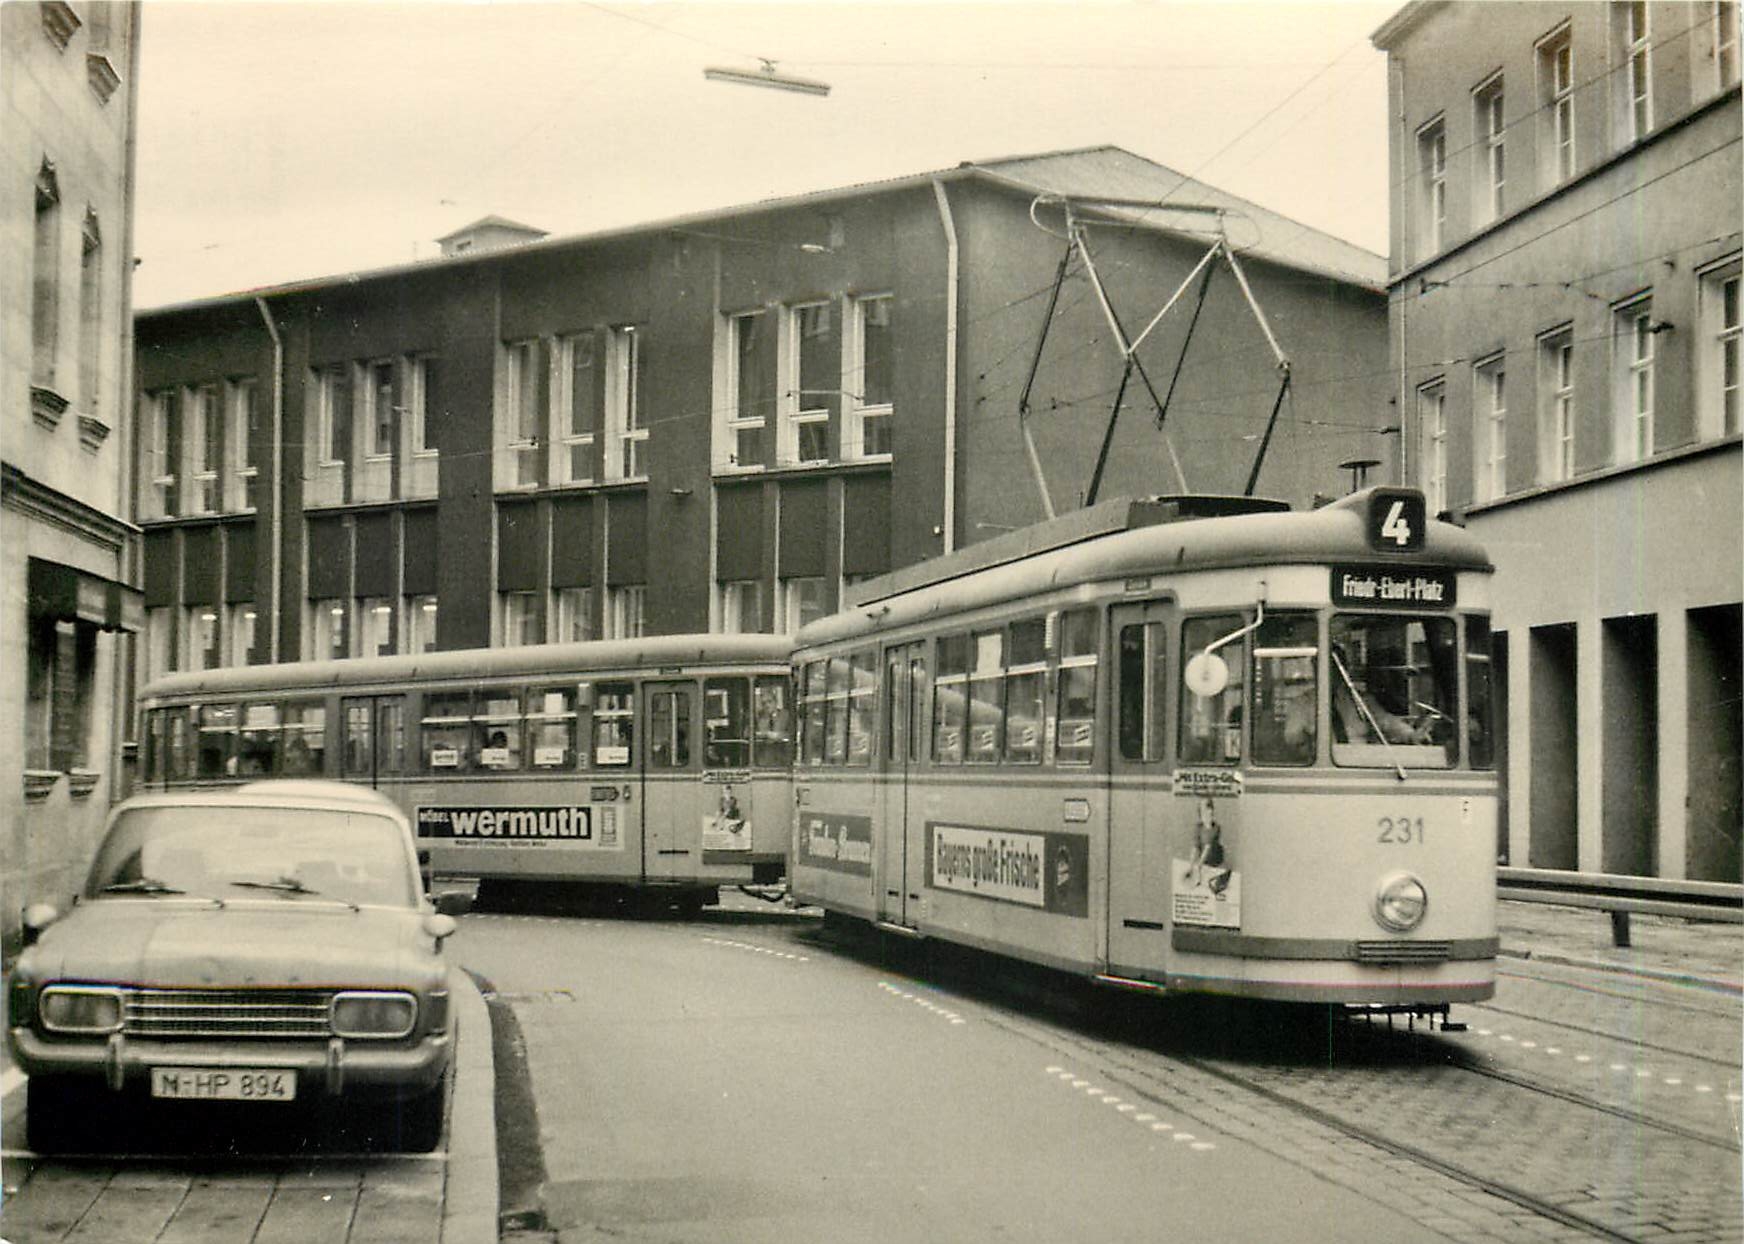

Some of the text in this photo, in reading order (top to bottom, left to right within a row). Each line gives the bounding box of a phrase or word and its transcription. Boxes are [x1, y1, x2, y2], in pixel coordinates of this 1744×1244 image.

[1381, 500, 1411, 545] 4
[451, 807, 589, 837] wermuth
[1377, 816, 1424, 844] 231
[937, 833, 971, 884] Bayerns
[1000, 839, 1039, 890] Frische
[240, 1074, 285, 1097] 894
